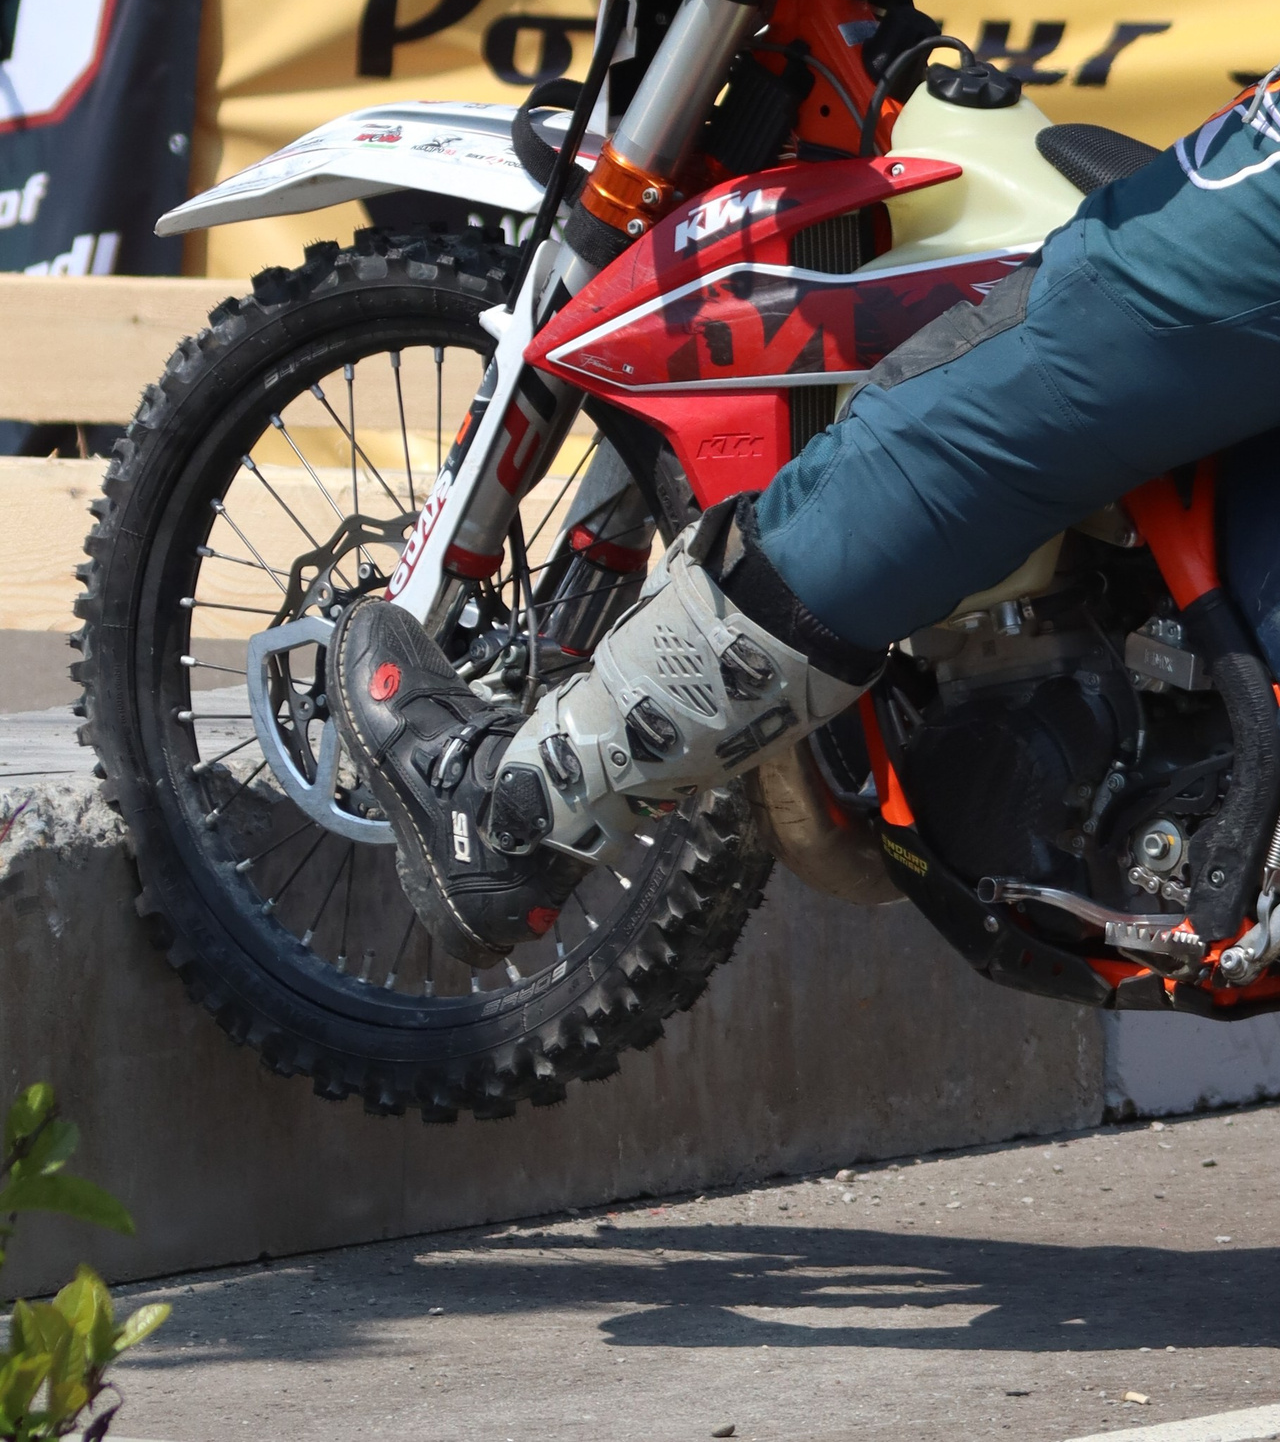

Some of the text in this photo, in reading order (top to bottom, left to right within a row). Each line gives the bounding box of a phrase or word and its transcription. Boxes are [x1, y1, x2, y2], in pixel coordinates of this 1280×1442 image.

[674, 185, 765, 252] KTM
[696, 434, 765, 460] KTM
[389, 469, 453, 596] 6DAYS
[881, 832, 928, 871] ENDURO
